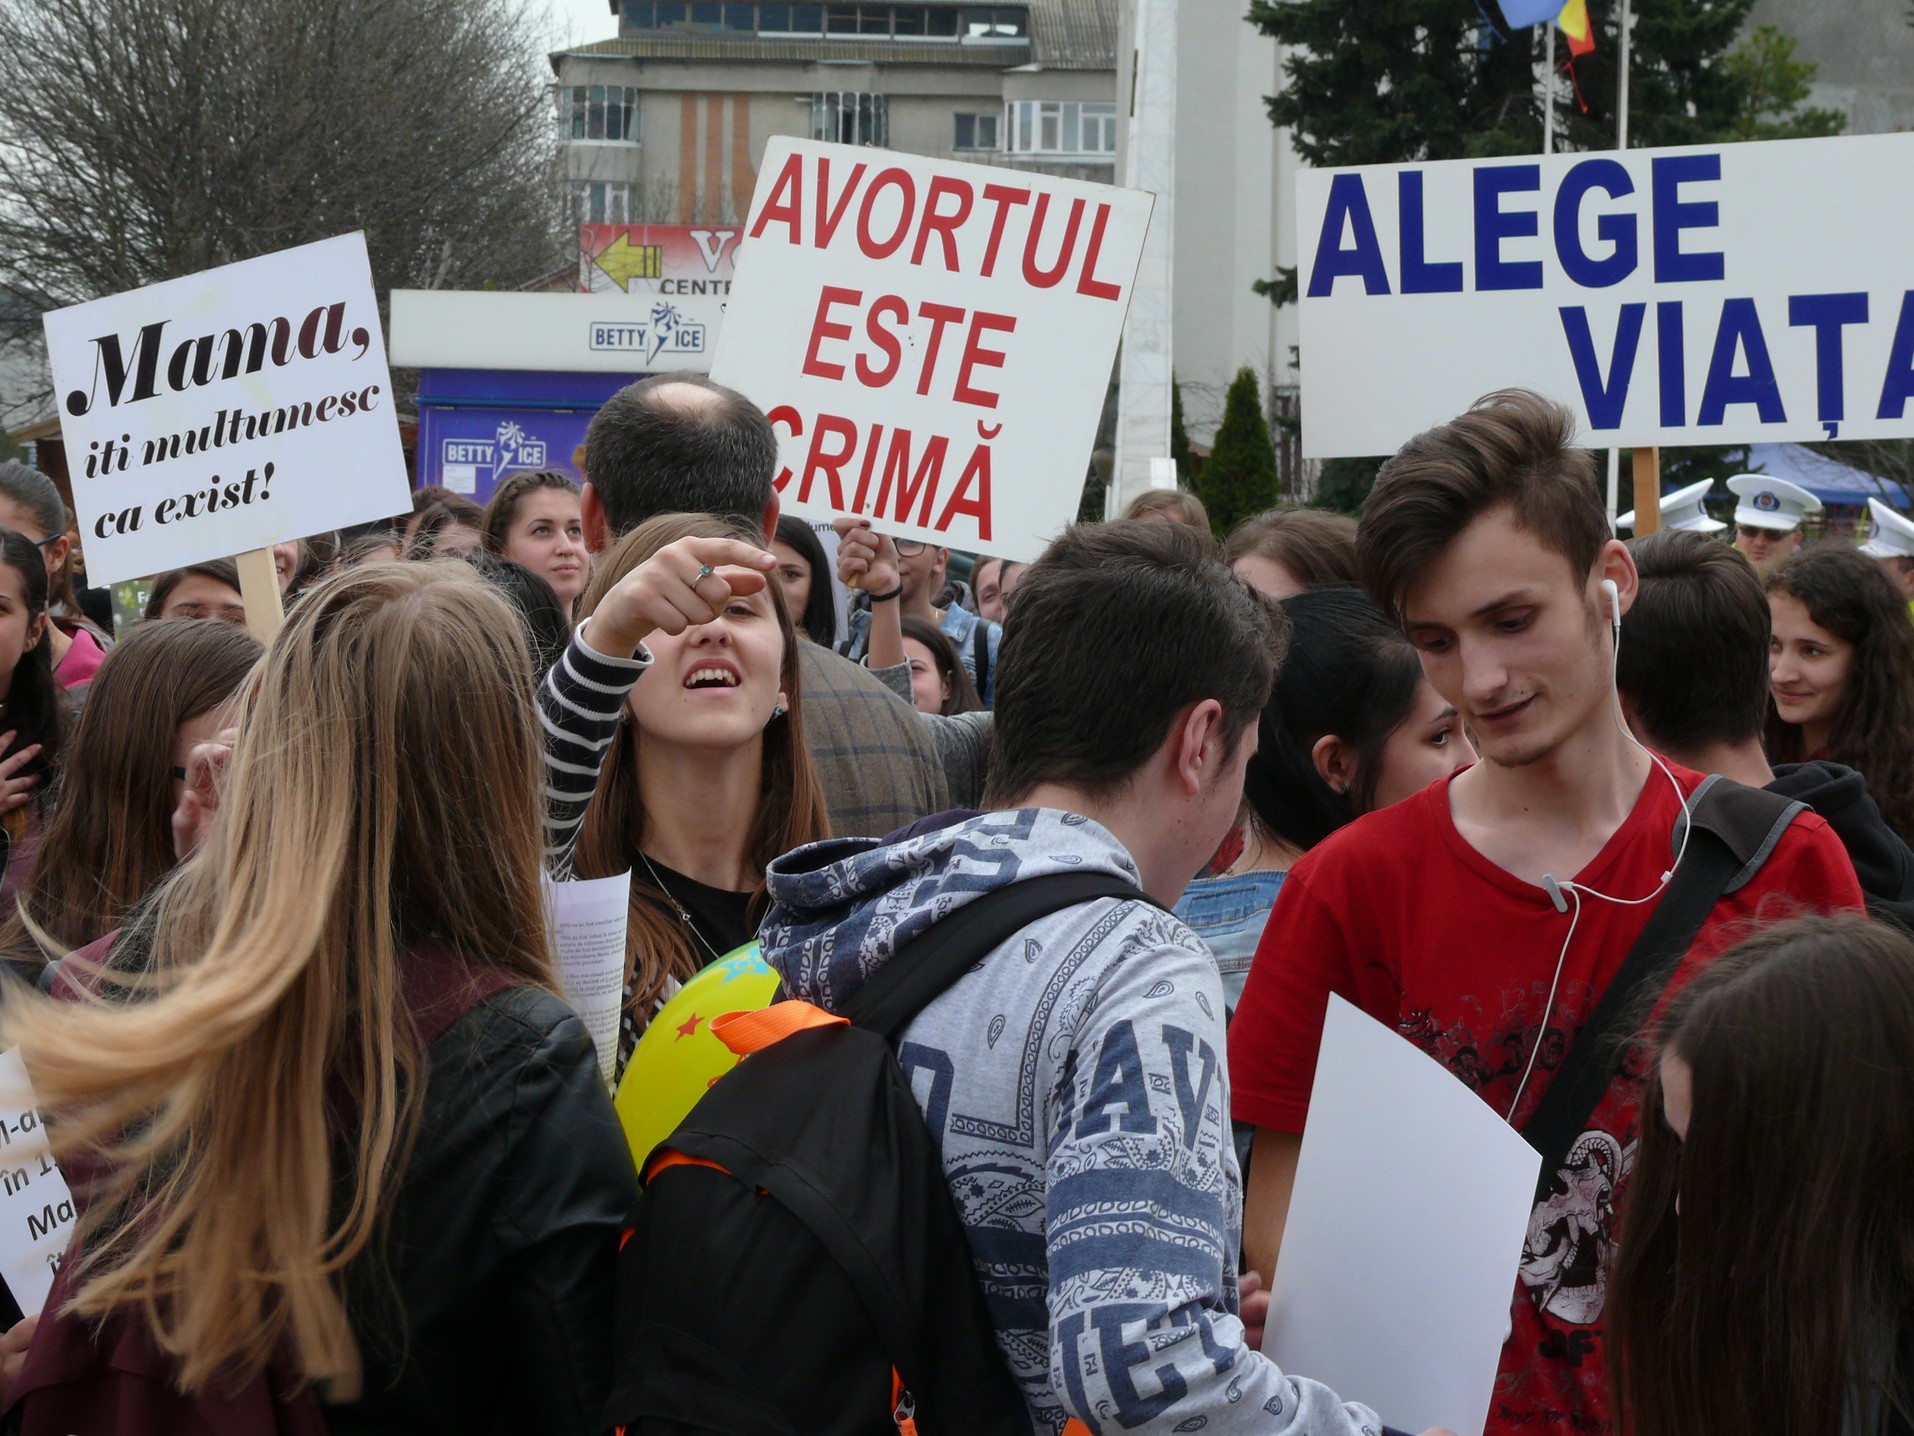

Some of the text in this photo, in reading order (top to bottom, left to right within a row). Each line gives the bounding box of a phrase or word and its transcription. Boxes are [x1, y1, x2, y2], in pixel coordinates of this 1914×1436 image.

[749, 153, 1122, 302] AVORTUL
[1307, 153, 1726, 297] ALEGE
[66, 300, 371, 417] Mama,
[595, 328, 700, 347] BETTY ICE
[802, 286, 1017, 410] ESTE
[84, 384, 380, 479] iti multumesc
[447, 444, 541, 464] BETTY ICE
[94, 462, 276, 539] ca exist!
